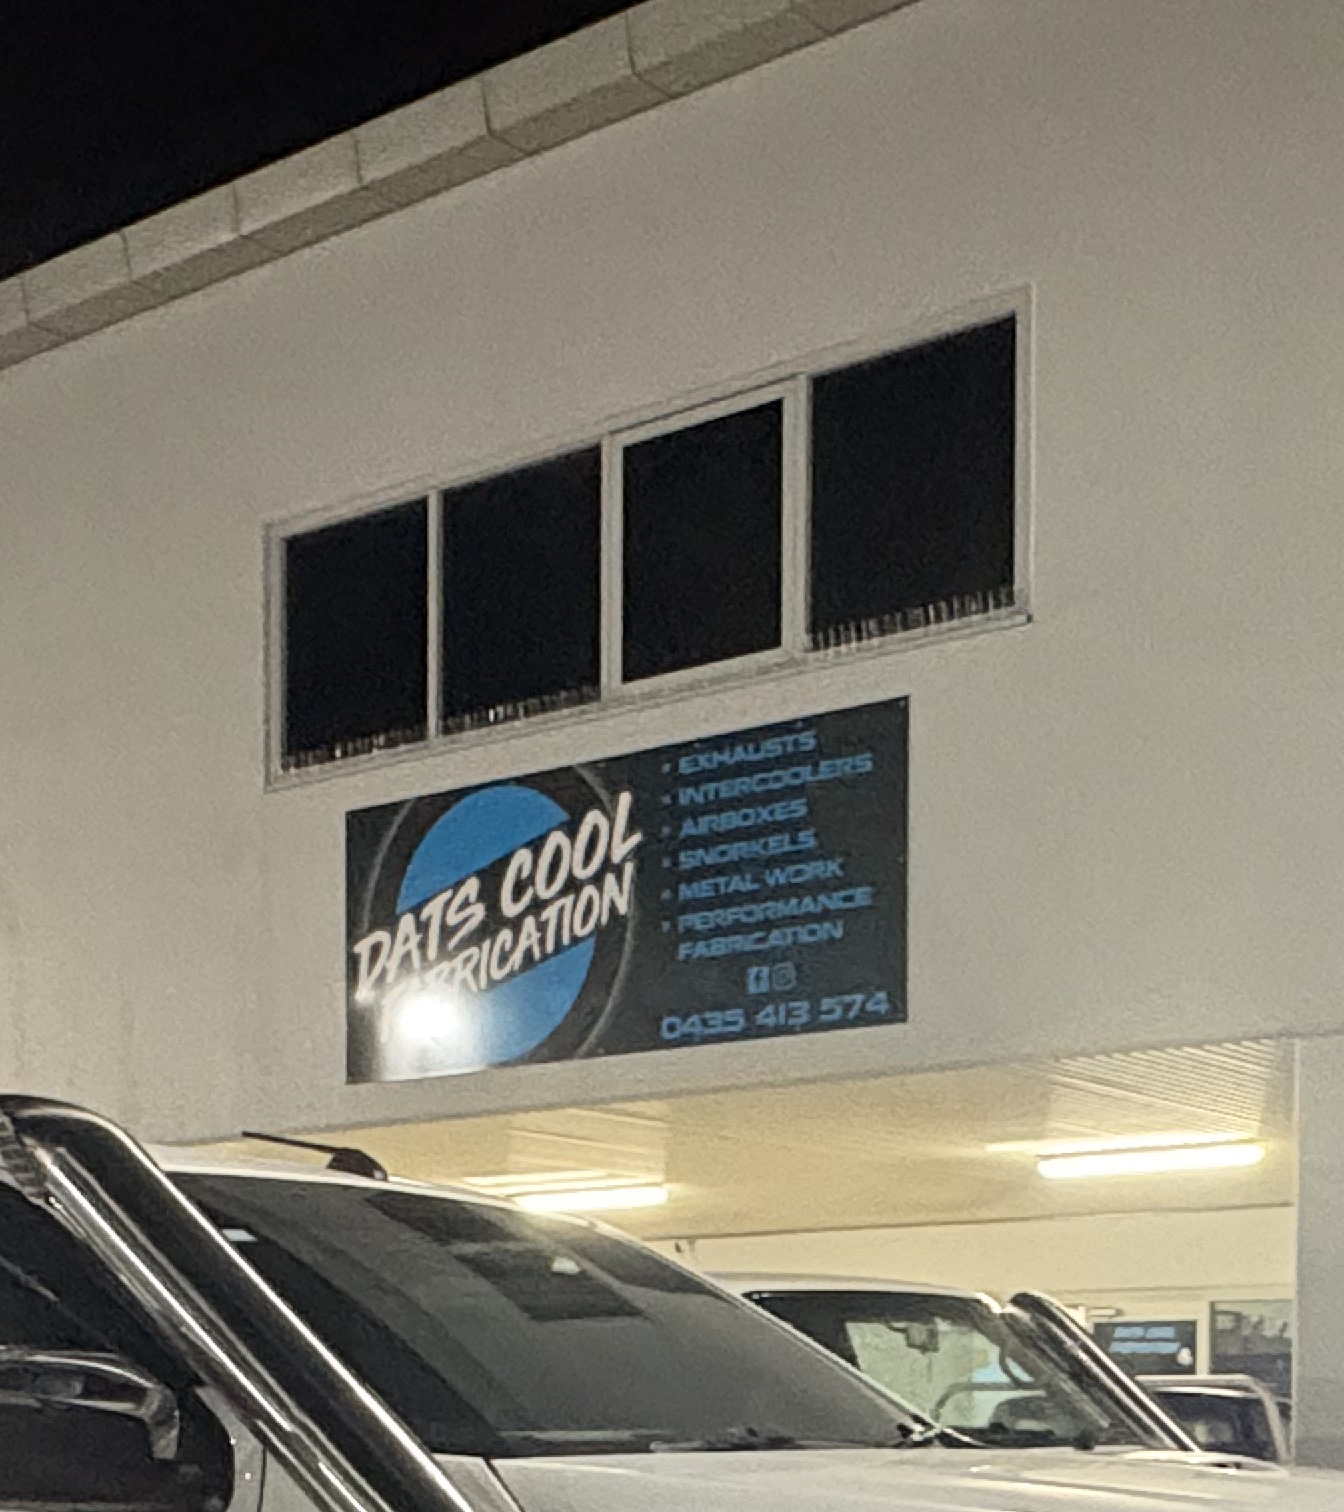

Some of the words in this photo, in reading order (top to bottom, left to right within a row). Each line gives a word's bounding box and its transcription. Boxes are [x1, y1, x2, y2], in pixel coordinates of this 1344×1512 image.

[678, 730, 817, 775] EXHAUSTS
[678, 752, 873, 806] INTERCOOLERS
[678, 798, 808, 840] AIRBOXES
[678, 828, 817, 871] SNORKELS
[353, 876, 487, 1000] DATS
[501, 791, 643, 918] COOL
[678, 873, 760, 900] METAL
[765, 857, 844, 885] WORK
[678, 886, 873, 934] PERFORMANCE
[677, 919, 844, 961] FABRICATION
[661, 1008, 745, 1041] 0435
[756, 1001, 810, 1028] 413
[820, 990, 890, 1021] 574
